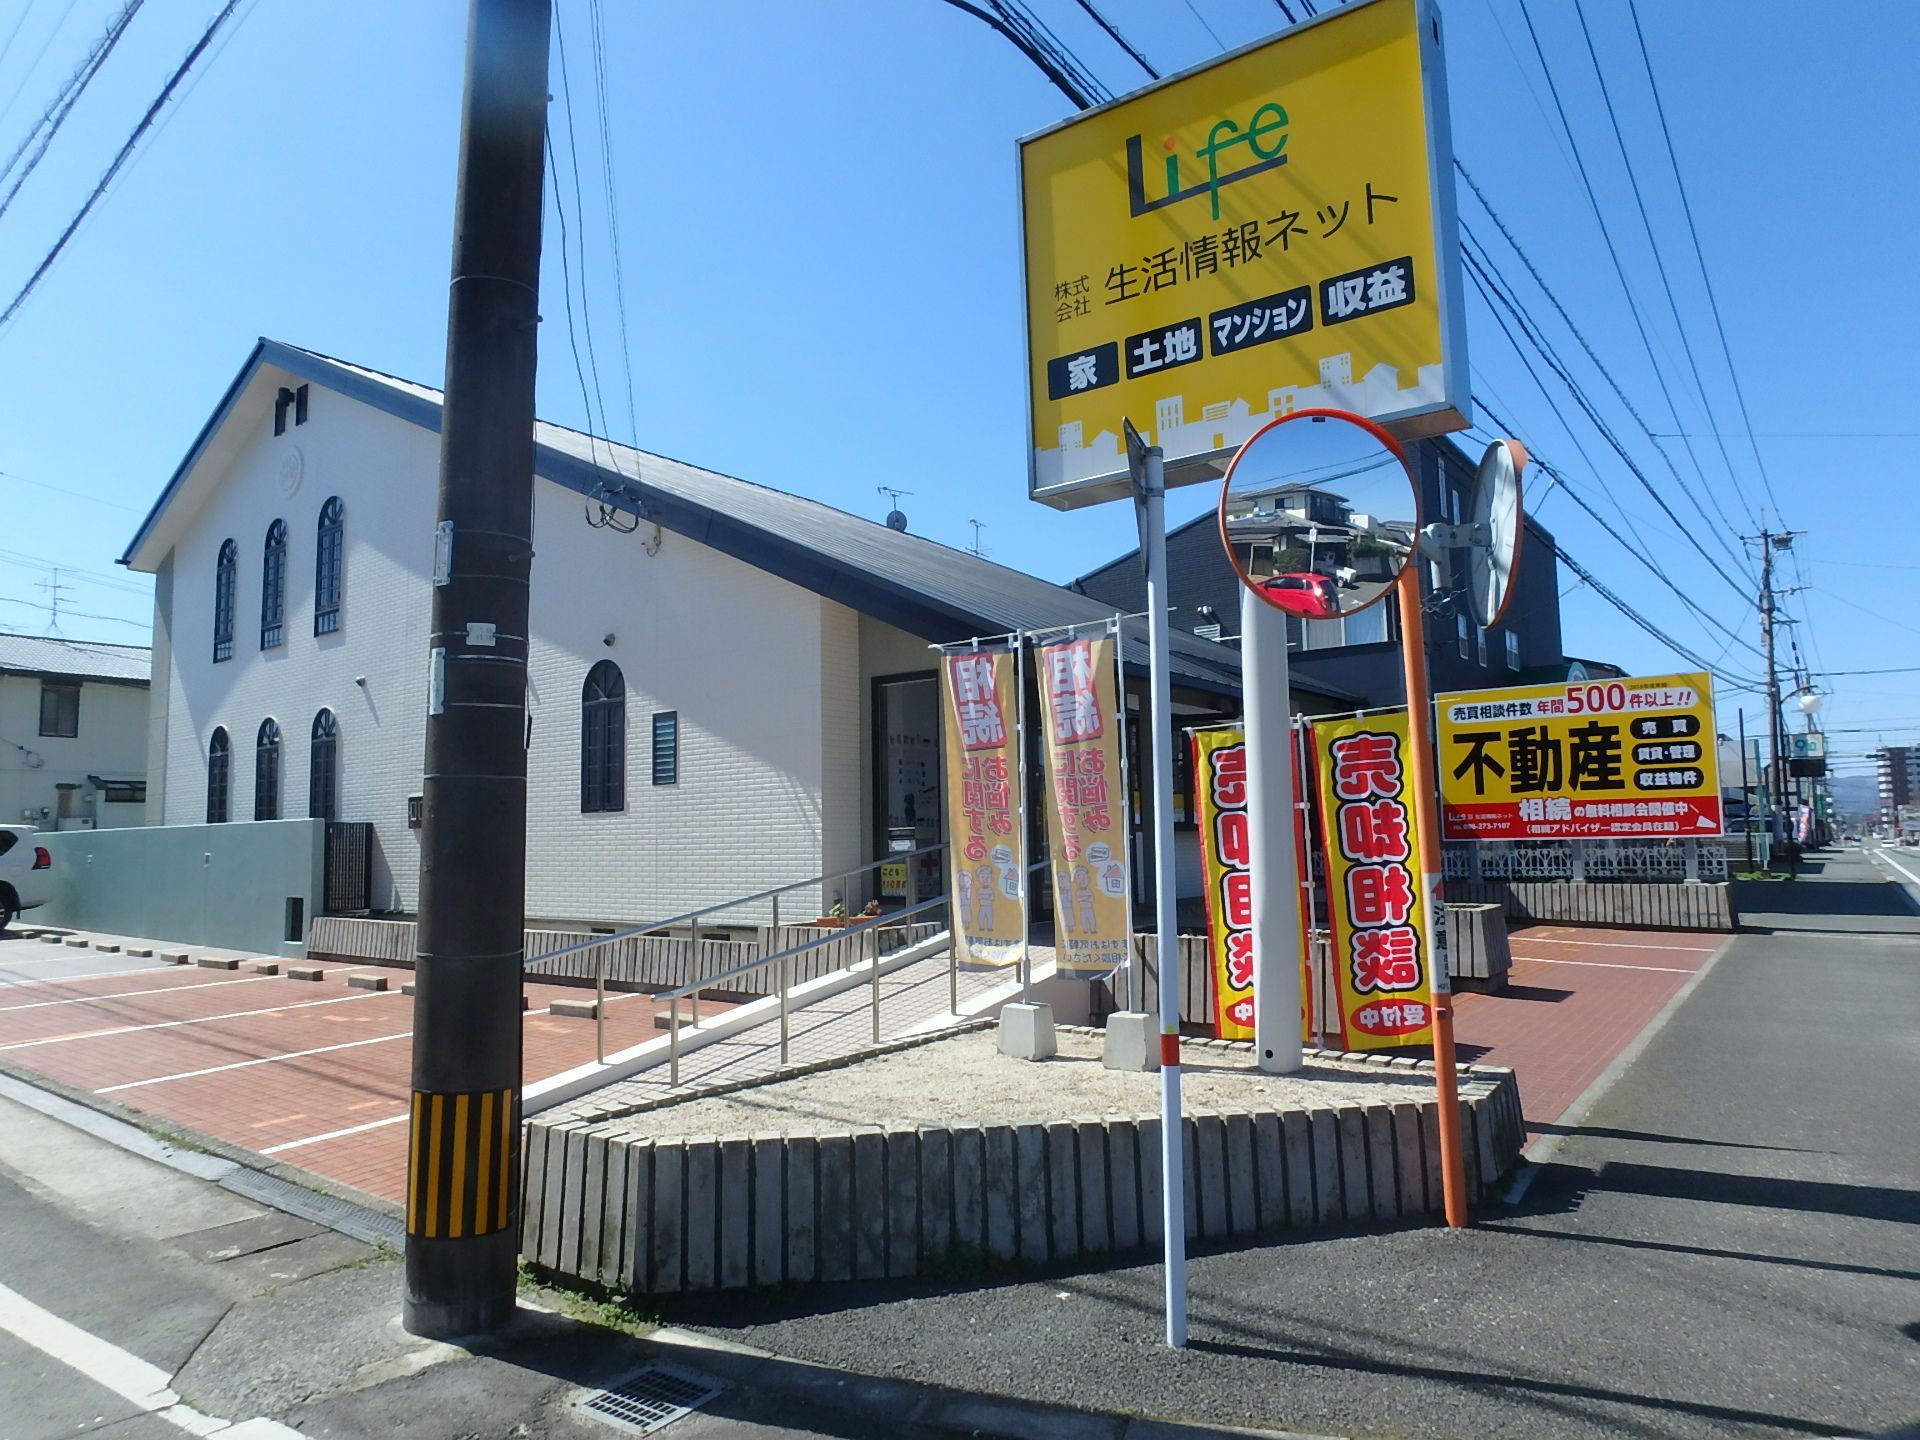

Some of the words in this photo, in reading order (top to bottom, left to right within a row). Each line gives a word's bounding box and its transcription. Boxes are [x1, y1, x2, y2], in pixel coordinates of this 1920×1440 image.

[1125, 102, 1290, 221] Life
[1104, 182, 1399, 306] 生活情報ネット
[1067, 355, 1099, 391] 家
[1133, 330, 1198, 375] 土地
[1213, 297, 1308, 347] マンション
[1328, 265, 1408, 318] 収益
[1453, 702, 1532, 721] 売買相談件数
[1453, 720, 1626, 796] 不動産
[1639, 771, 1698, 786] 収益物件
